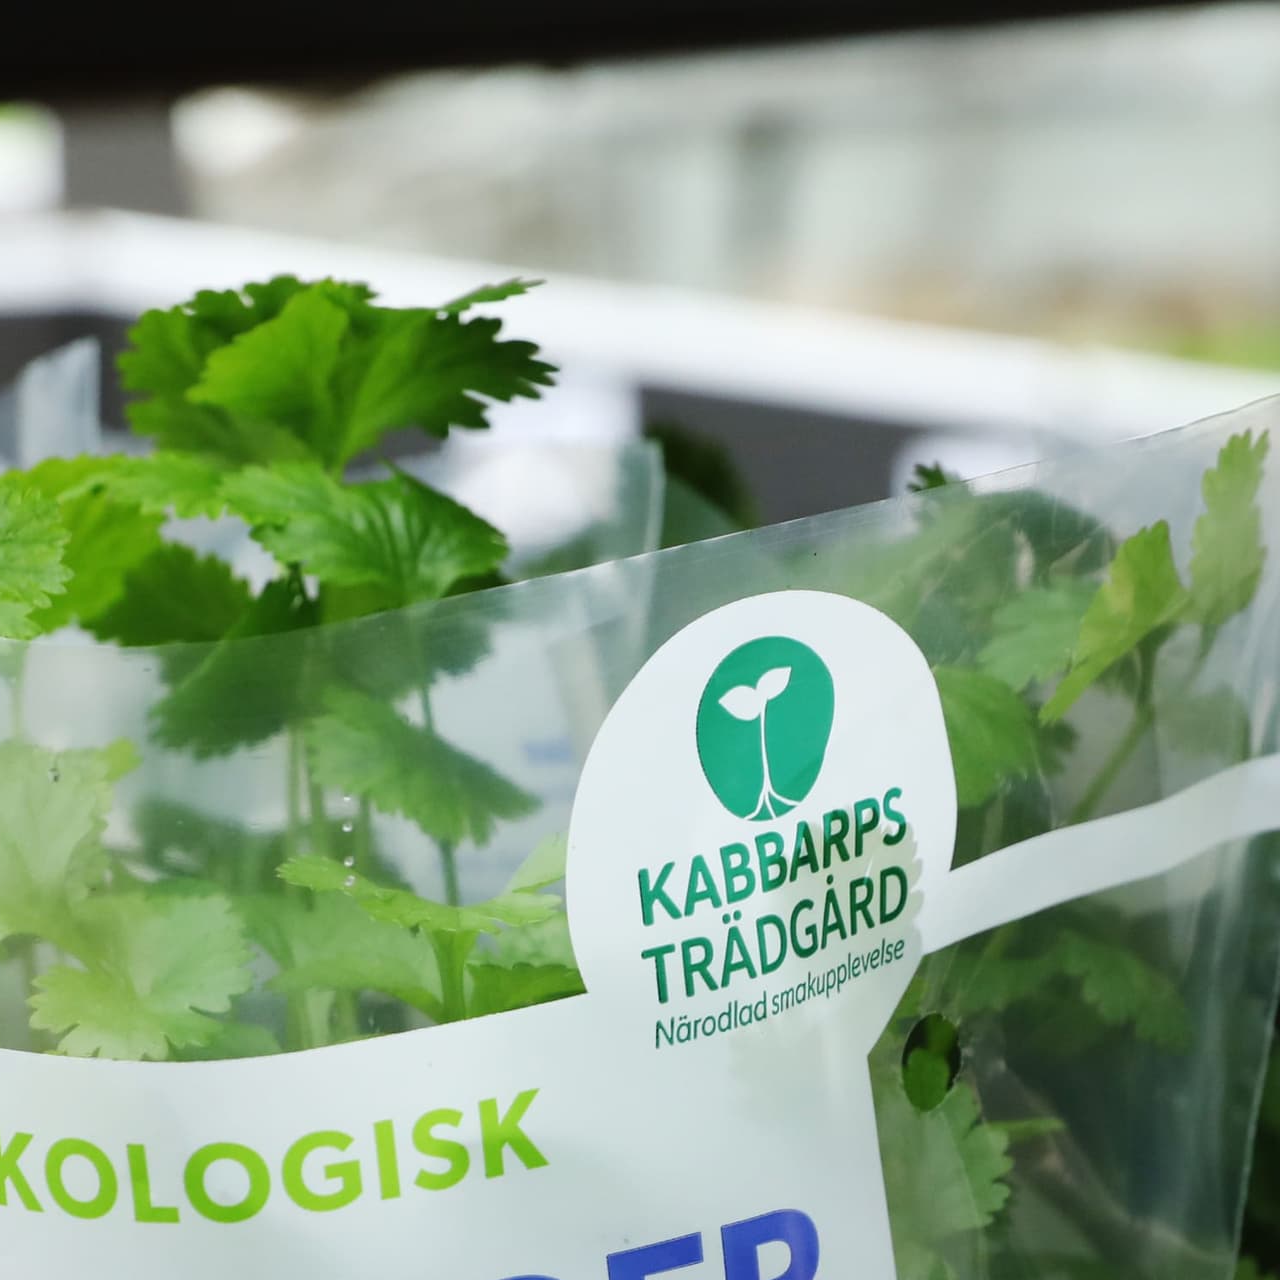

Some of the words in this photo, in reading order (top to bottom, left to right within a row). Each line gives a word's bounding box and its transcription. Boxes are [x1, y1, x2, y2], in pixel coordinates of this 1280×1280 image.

[637, 786, 908, 927] KABBARPS
[640, 865, 909, 1004] TRÄDGÅRD
[655, 991, 768, 1049] Närodlad
[771, 938, 906, 1018] smakupplevelse
